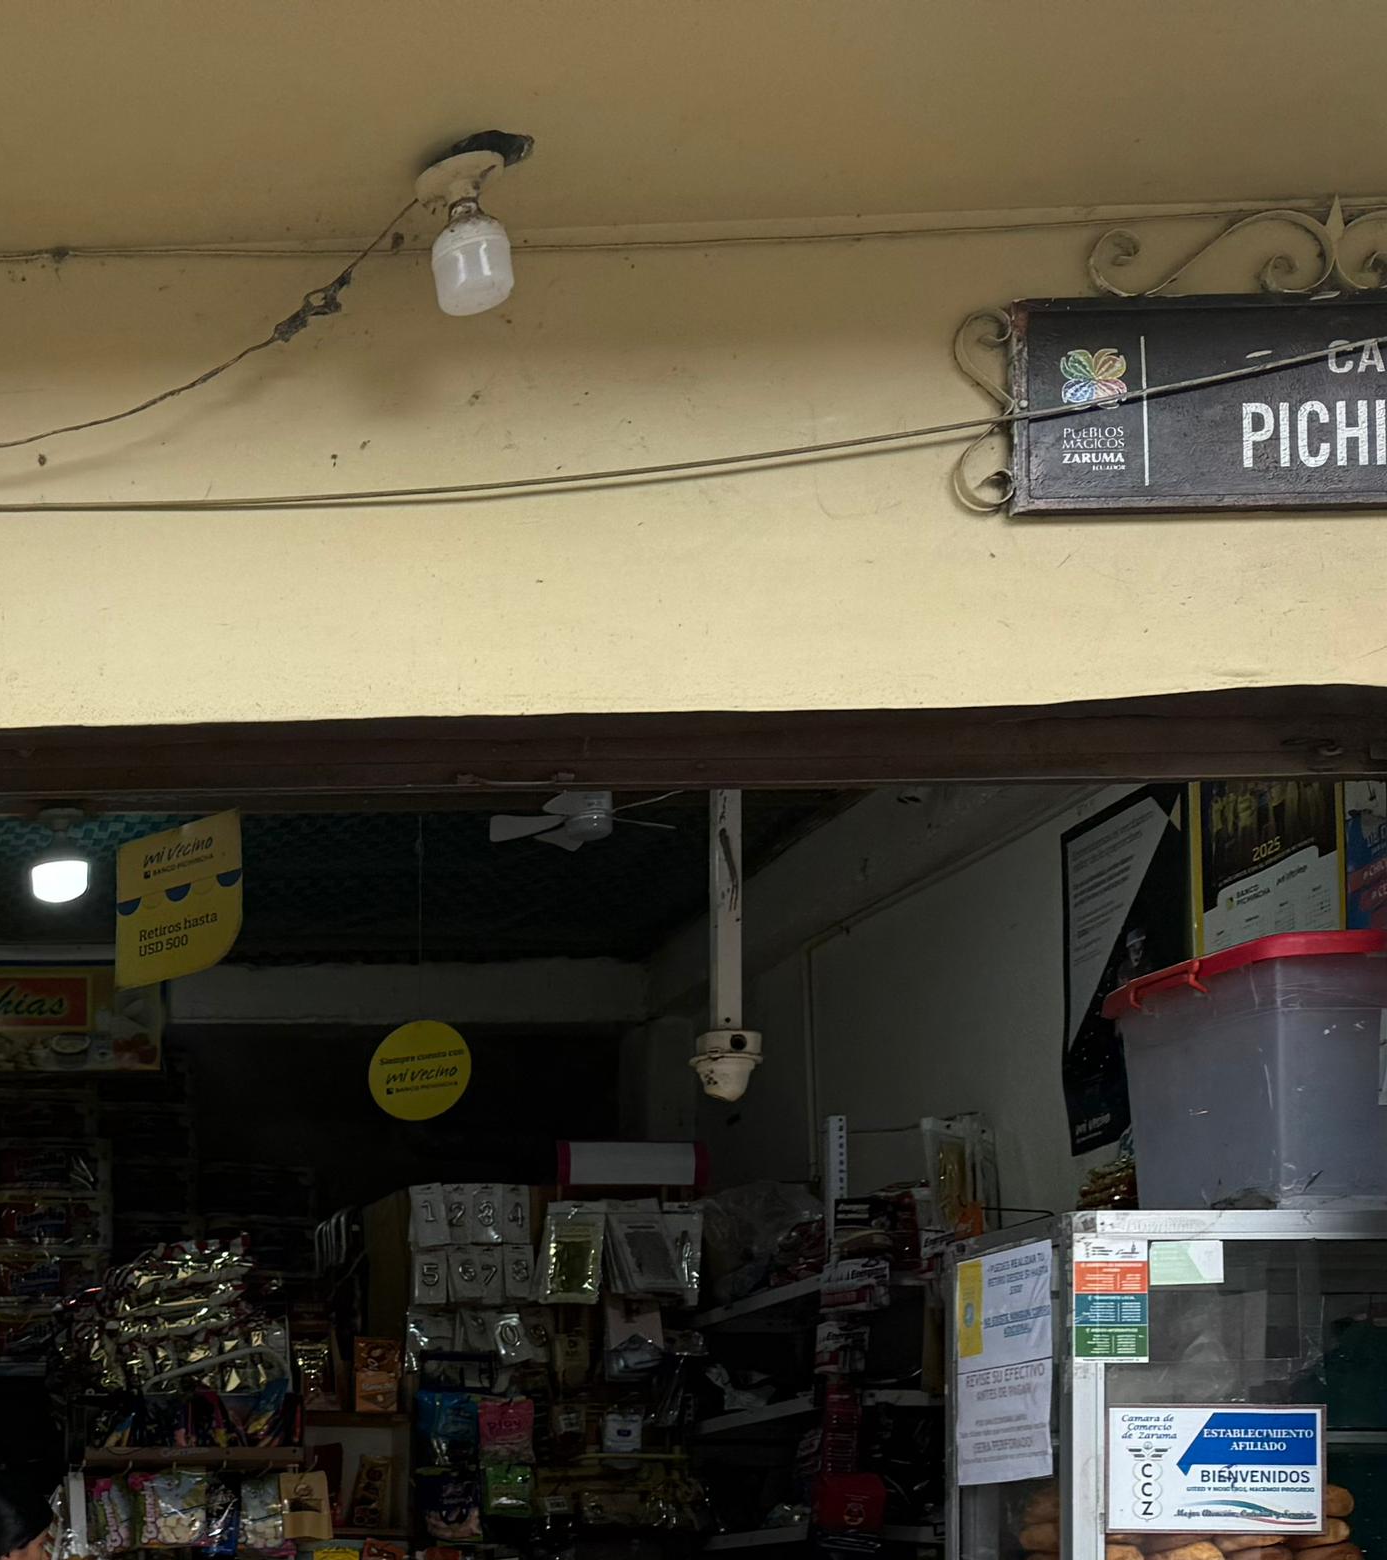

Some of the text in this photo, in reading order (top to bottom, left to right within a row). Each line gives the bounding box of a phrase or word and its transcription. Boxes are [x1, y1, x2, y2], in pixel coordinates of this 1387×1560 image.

[1063, 426, 1124, 438] PUEBLOS
[1062, 453, 1125, 464] ZARUMA
[1250, 836, 1282, 862] 2025
[139, 912, 218, 942] Retiros hasta
[139, 934, 189, 957] USD 500
[1121, 1414, 1174, 1423] Camara de
[1127, 1423, 1172, 1431] Comercio
[1121, 1431, 1177, 1440] de Zaruma
[1203, 1429, 1314, 1439] ESTABLECIMIENTO
[1230, 1441, 1287, 1451] AFILIADO
[1141, 1463, 1152, 1478] C
[1200, 1469, 1311, 1483] BIENVENIDOS
[1141, 1482, 1152, 1497] C
[1141, 1501, 1154, 1516] Z
